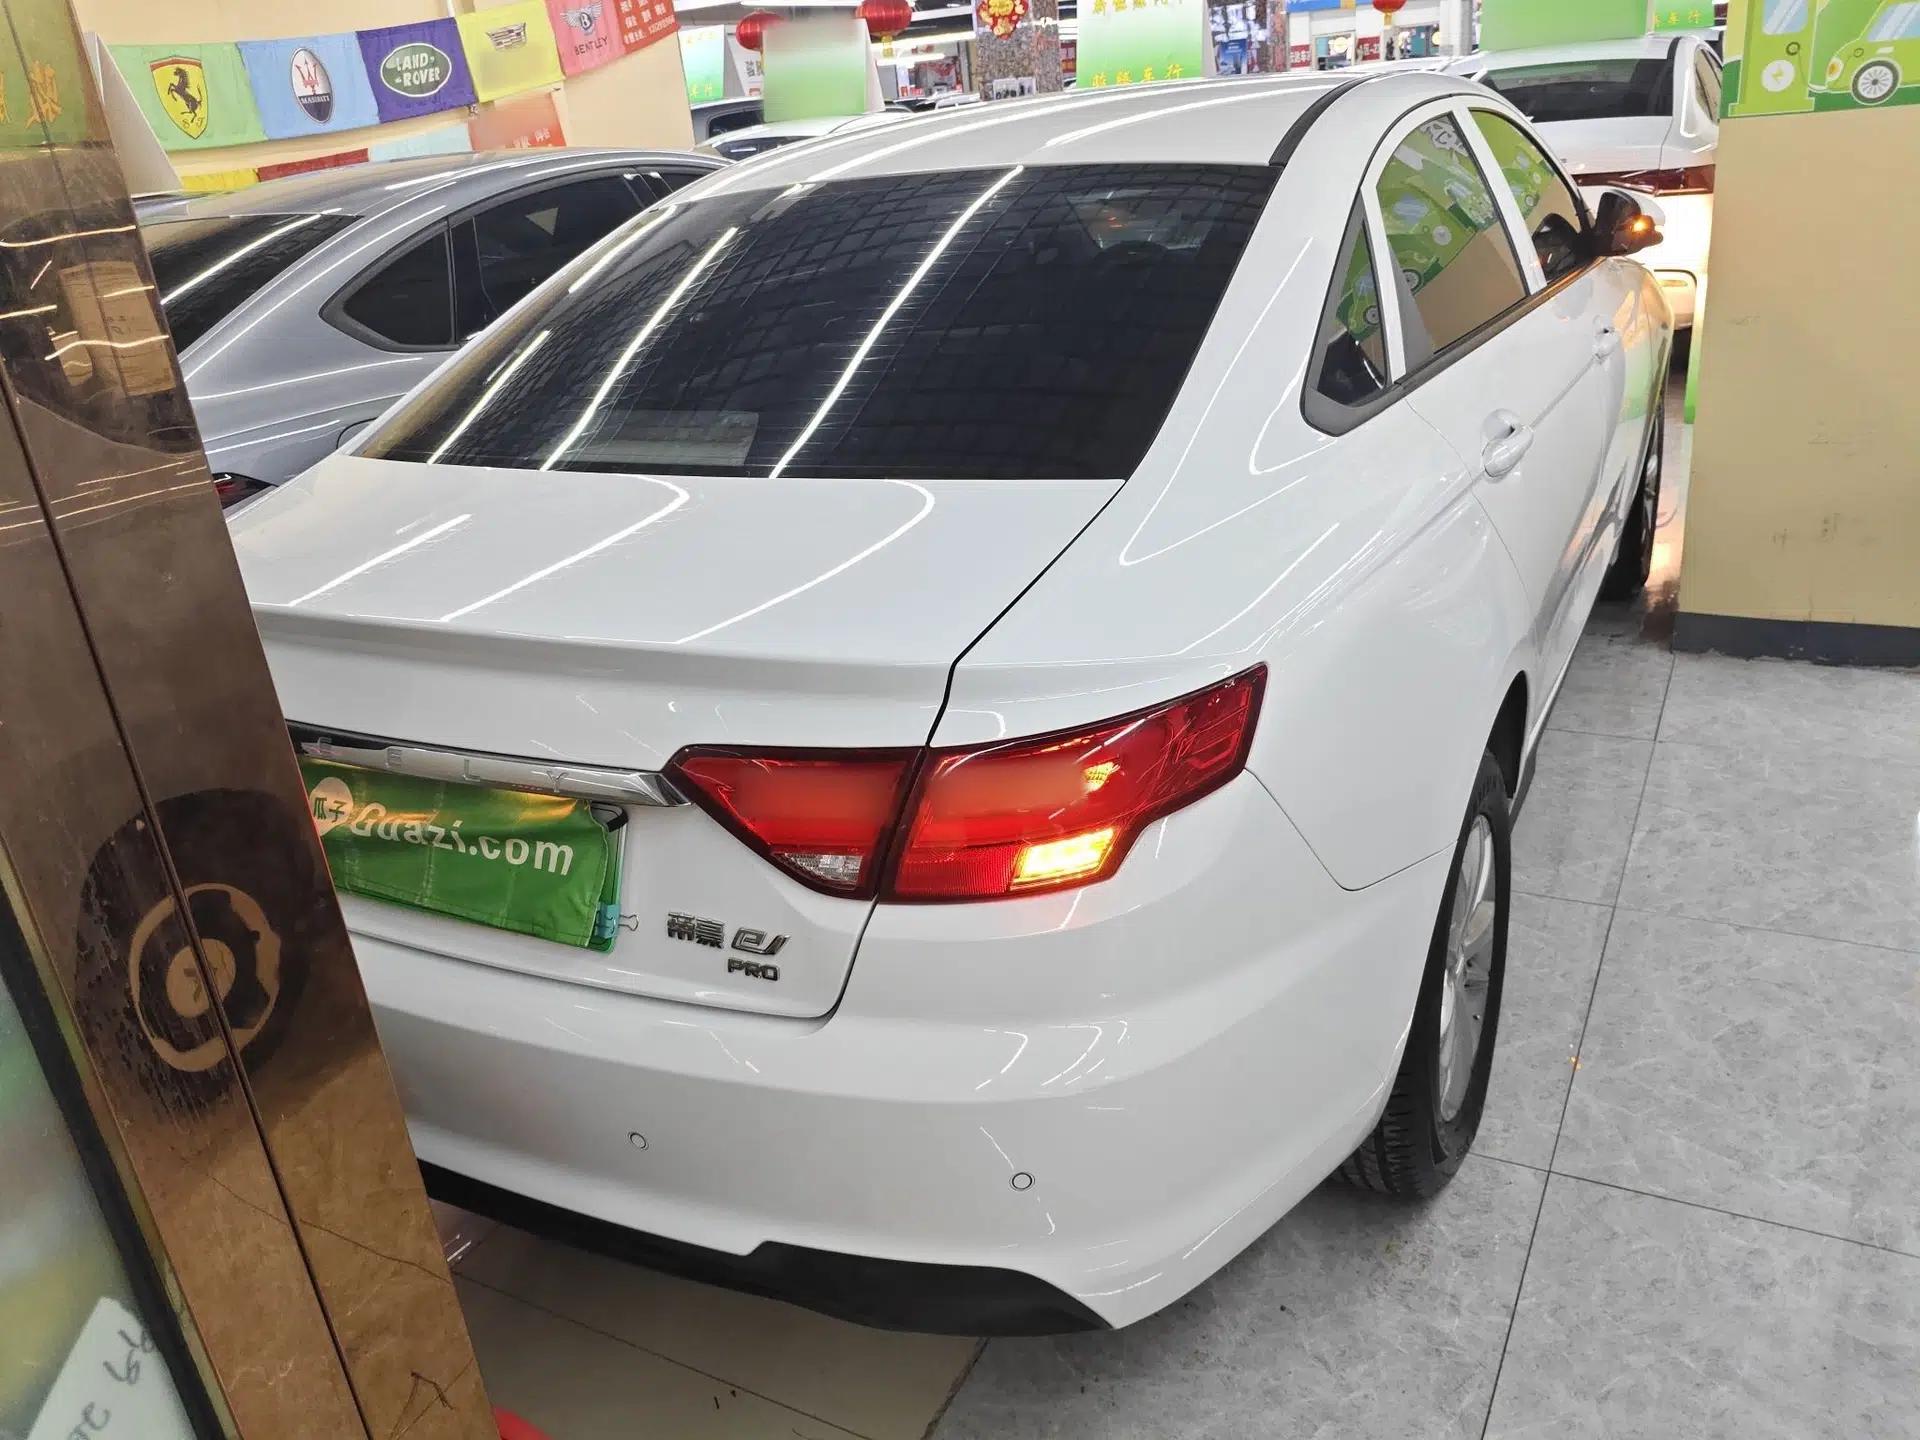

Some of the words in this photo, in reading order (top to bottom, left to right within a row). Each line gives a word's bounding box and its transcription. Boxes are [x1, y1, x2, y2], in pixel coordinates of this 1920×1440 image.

[574, 36, 608, 55] BENTLEY
[396, 53, 428, 71] LAND
[403, 67, 440, 87] ROVER
[311, 796, 345, 823] 瓜子
[350, 802, 574, 876] Guazi.com
[727, 958, 780, 981] PRO
